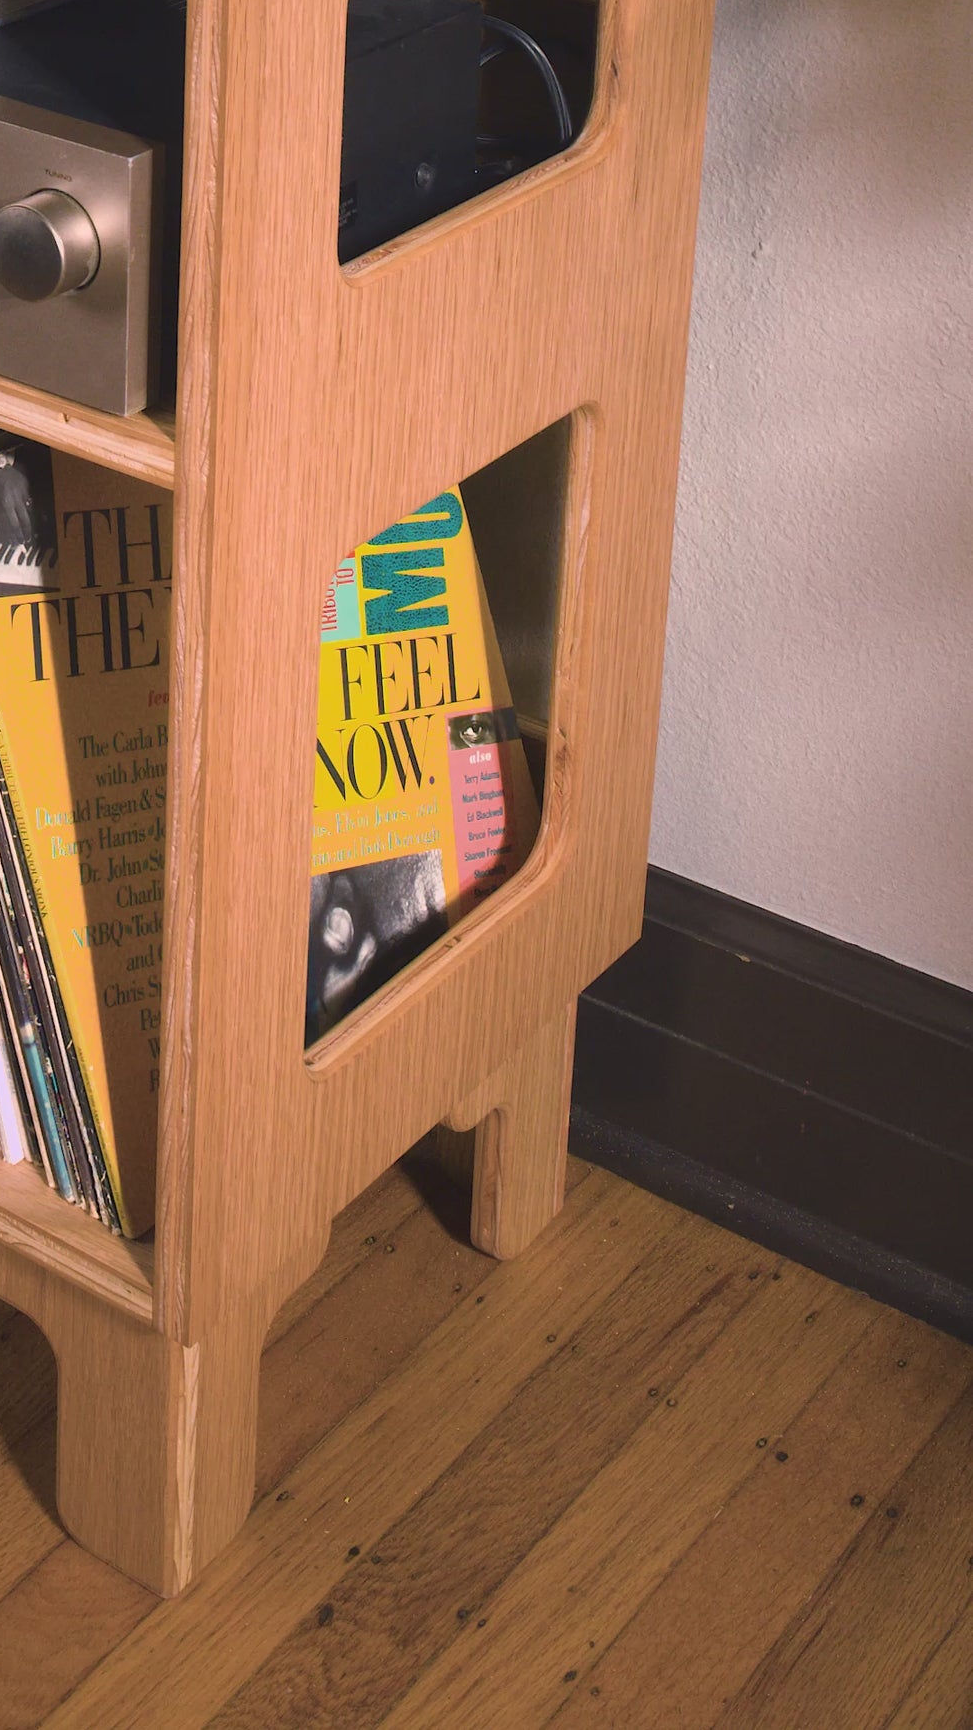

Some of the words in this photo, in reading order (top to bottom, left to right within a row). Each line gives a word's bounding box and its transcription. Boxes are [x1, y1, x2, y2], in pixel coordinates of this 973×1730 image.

[44, 168, 73, 183] TUNING
[63, 503, 173, 590] TH
[334, 567, 355, 588] TO
[10, 588, 161, 683] THE
[339, 632, 481, 722] FEEL
[79, 735, 109, 759] The
[113, 727, 153, 754] Carla
[469, 750, 492, 765] also
[95, 761, 128, 788] with
[464, 773, 479, 785] Terry
[480, 770, 500, 782] Adams
[35, 799, 91, 831] Donald
[95, 796, 138, 822] Fagen
[139, 787, 153, 811] &
[462, 792, 478, 804] Mark
[467, 811, 475, 823] Ed
[476, 807, 504, 821] Blackwell
[51, 835, 94, 861] Barry
[99, 822, 146, 850] Harris
[468, 831, 486, 842] Bruce
[79, 861, 100, 886] Dr.
[107, 853, 142, 882] John
[33, 886, 49, 919] MONK
[71, 919, 124, 948] NRBQ
[126, 943, 154, 972] and
[103, 982, 145, 1009] Chris
